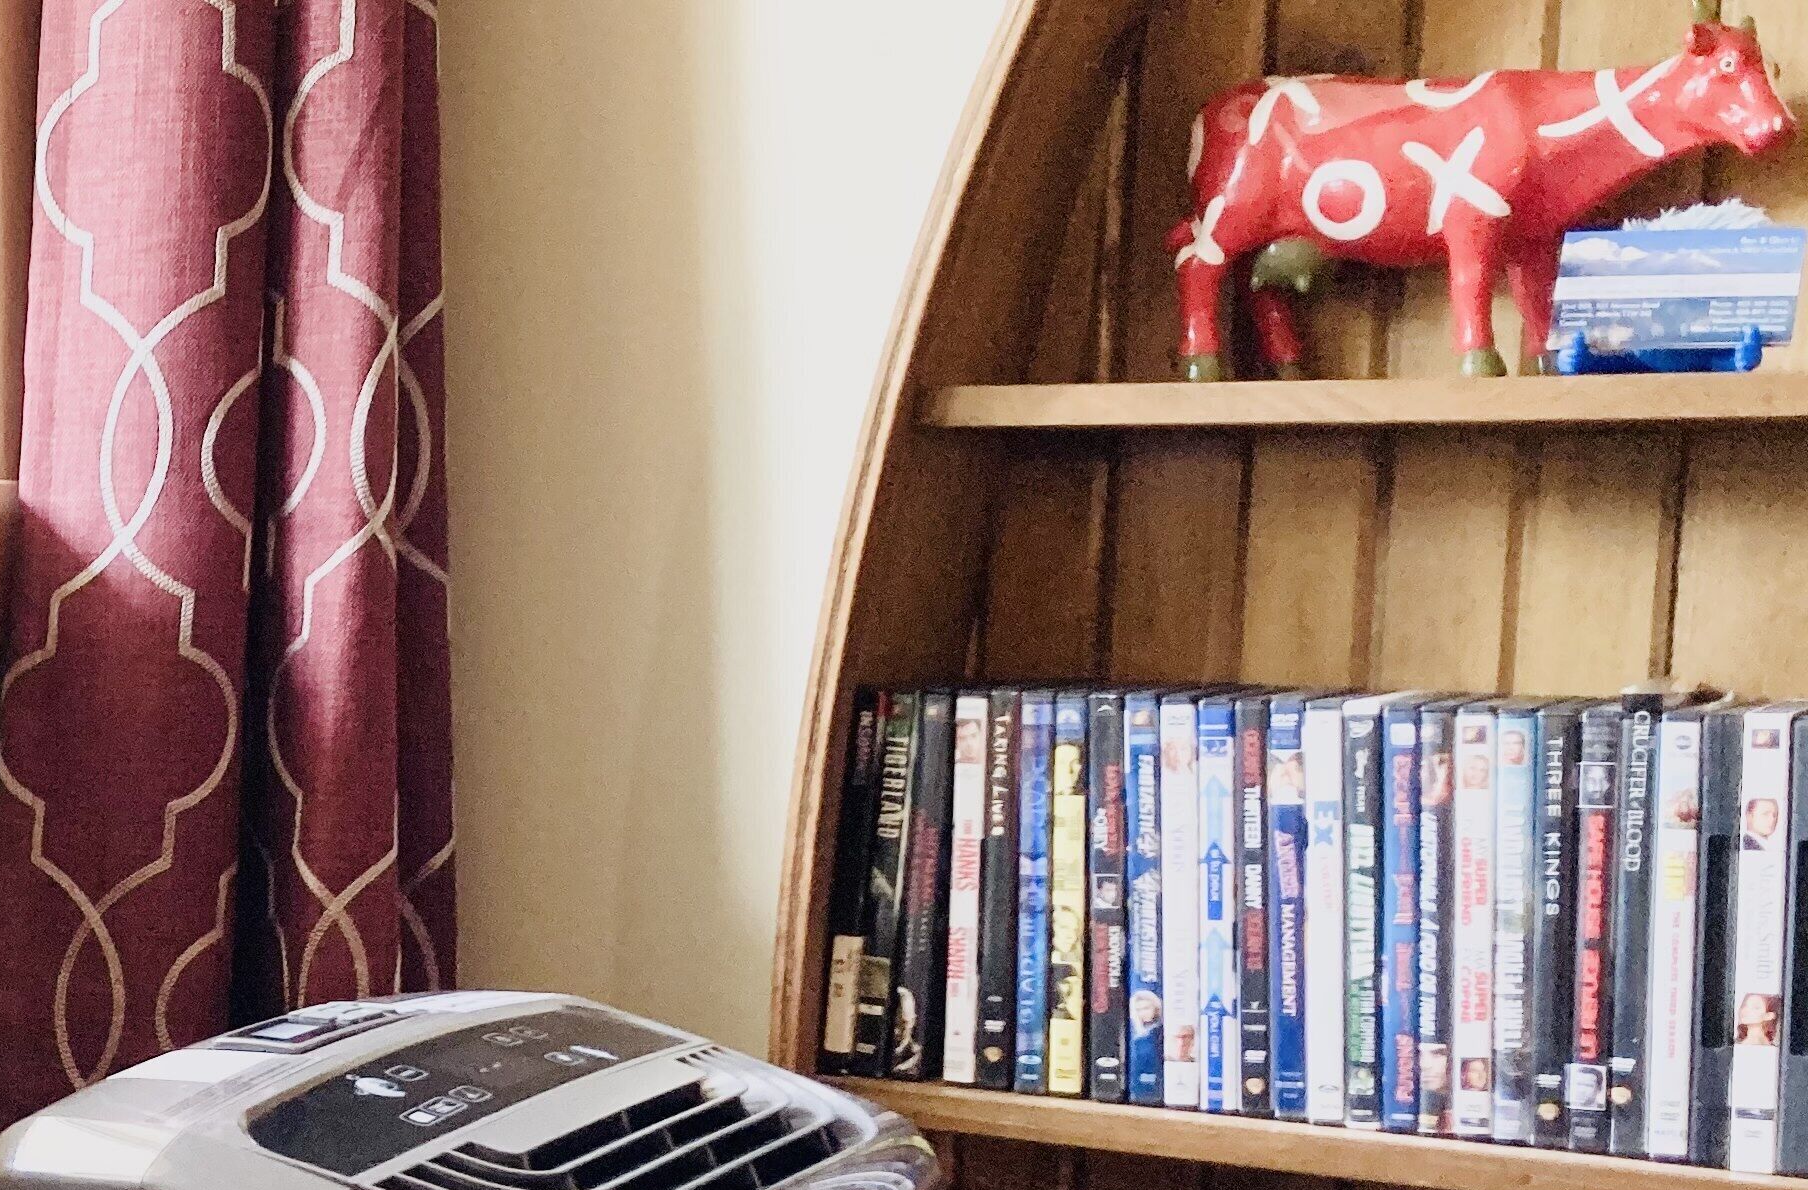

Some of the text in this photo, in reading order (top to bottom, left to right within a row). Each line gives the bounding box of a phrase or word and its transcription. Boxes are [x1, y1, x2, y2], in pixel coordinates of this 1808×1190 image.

[1626, 710, 1651, 800] CRUCIFER
[876, 735, 910, 839] TIGERLAND
[1244, 786, 1262, 849] THIRTEEN
[1544, 736, 1563, 916] THREE KINGS
[1621, 809, 1644, 871] BLOOD
[954, 837, 981, 892] HANKS
[1244, 864, 1262, 909] DANNY
[1475, 858, 1487, 906] SUPER
[1279, 903, 1297, 1017] MANAGEMENT
[1208, 1011, 1220, 1032] you
[1474, 971, 1487, 1021] SUPER
[1210, 1035, 1219, 1058] can
